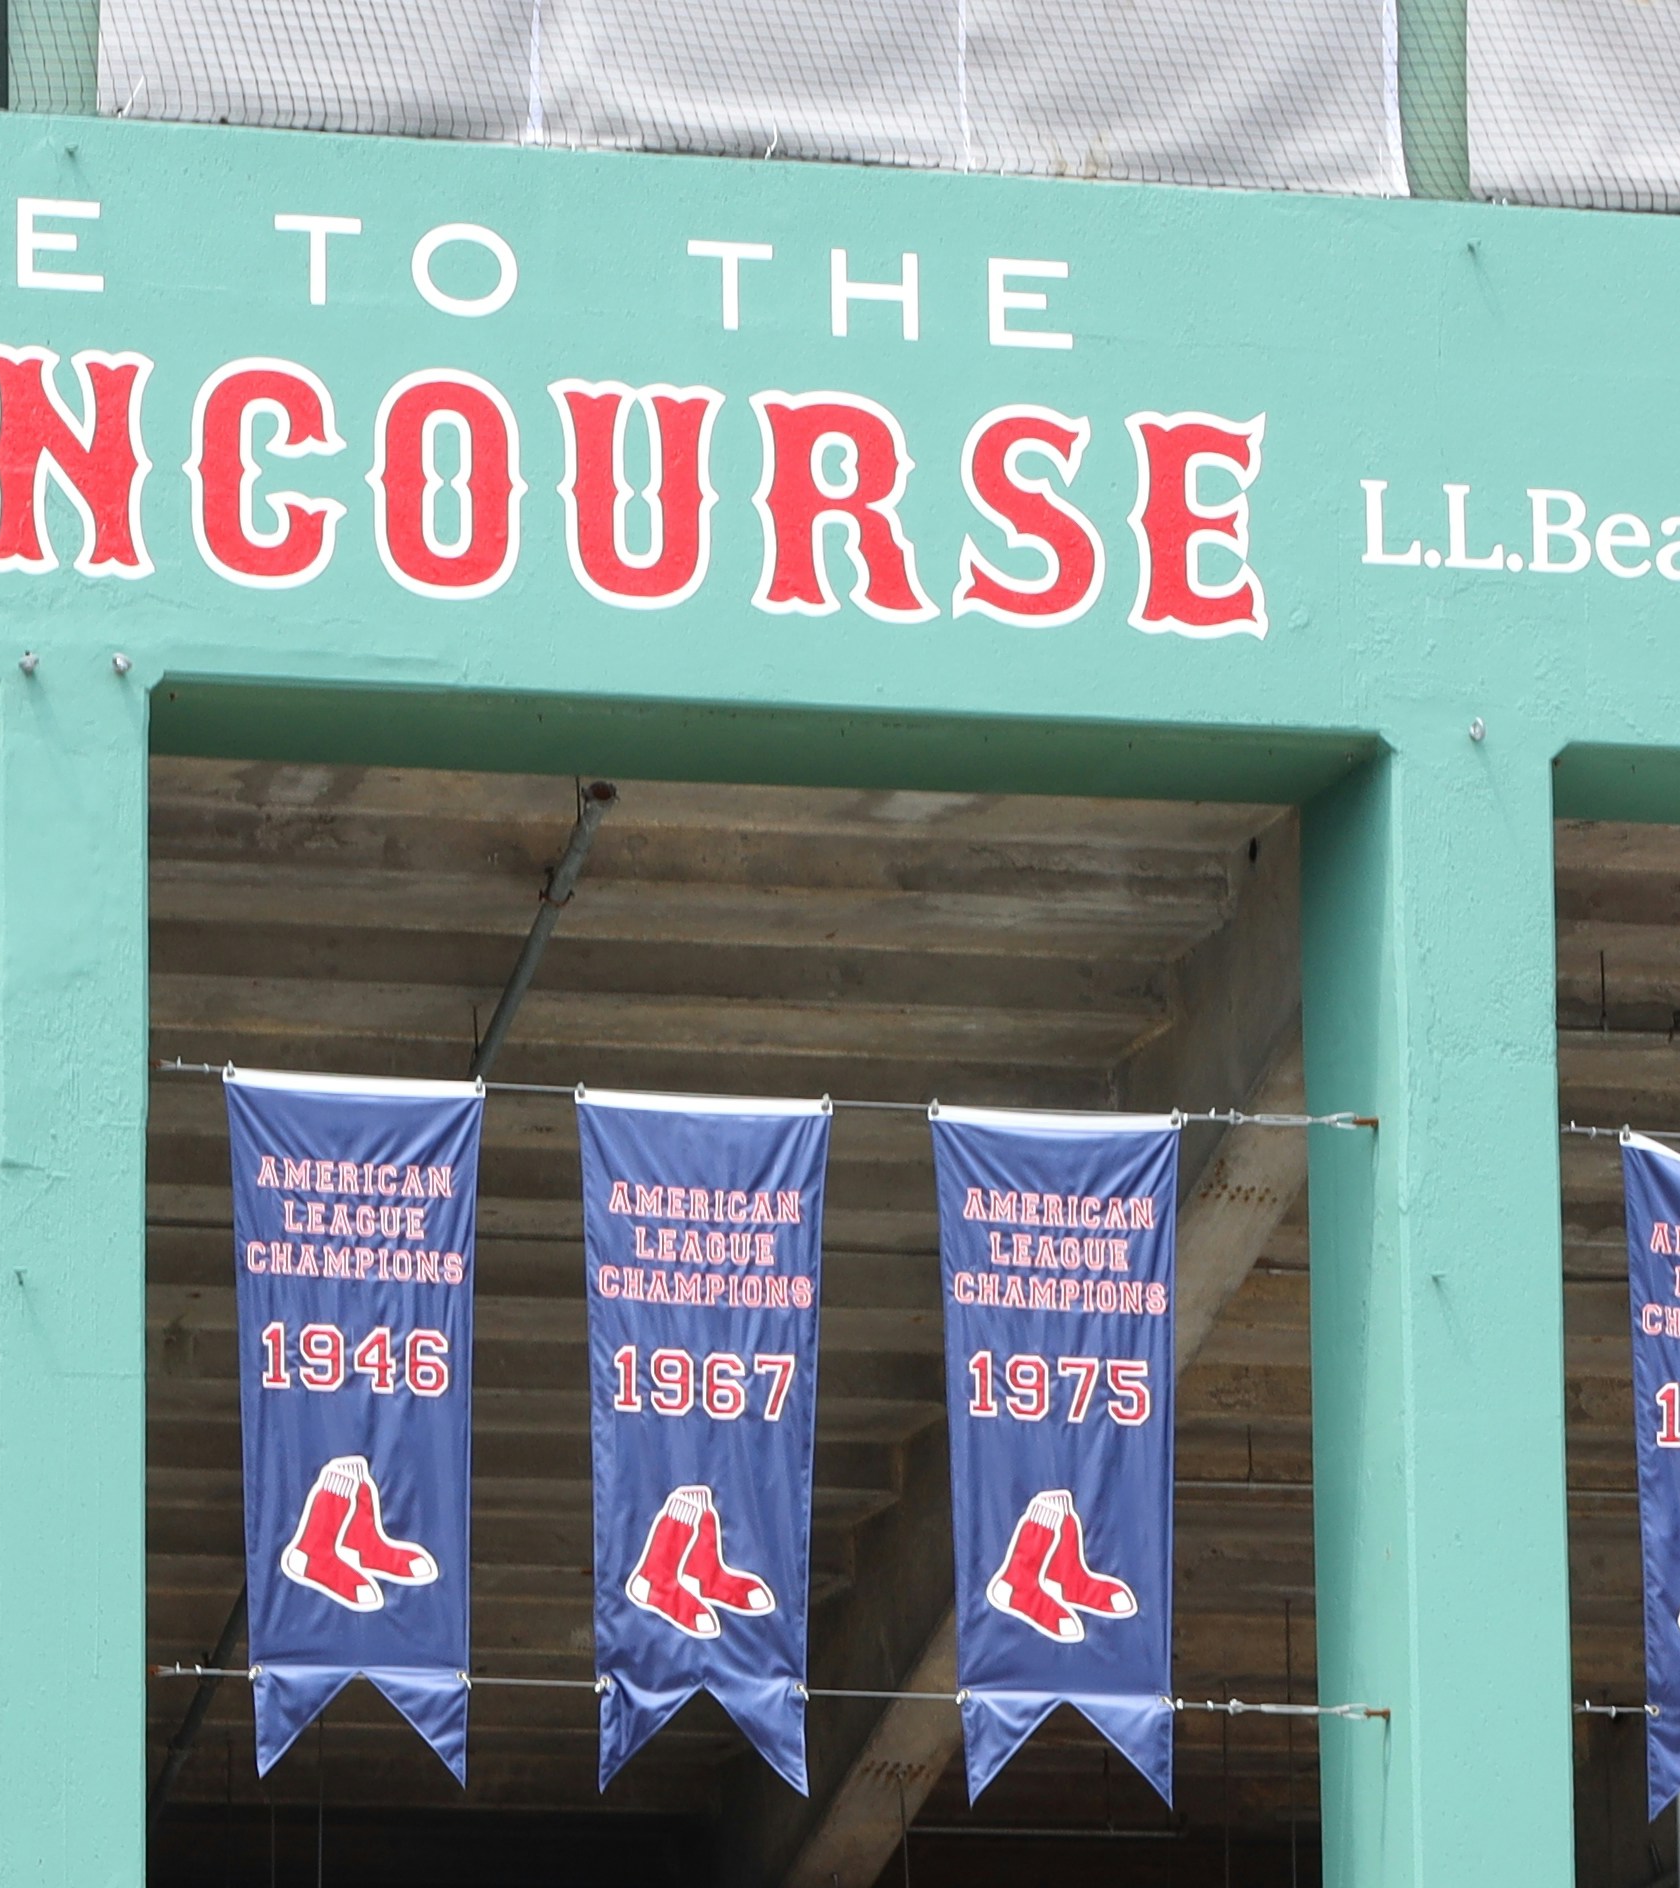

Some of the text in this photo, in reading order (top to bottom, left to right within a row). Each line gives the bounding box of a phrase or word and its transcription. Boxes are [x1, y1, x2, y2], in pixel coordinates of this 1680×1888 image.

[276, 215, 520, 316] TO
[689, 240, 1074, 348] THE
[257, 1156, 452, 1198] AMERICAN
[284, 1201, 425, 1241] LEAGUE
[609, 1181, 801, 1225] AMERICAN
[962, 1188, 1154, 1231] AMERICAN
[246, 1241, 464, 1286] CHAMPIONS
[635, 1226, 776, 1266] LEAGUE
[991, 1231, 1129, 1272] LEAGUE
[598, 1264, 813, 1309] CHAMPIONS
[954, 1272, 1168, 1315] CHAMPIONS
[261, 1321, 449, 1397] 1946
[612, 1344, 796, 1421] 1967
[968, 1350, 1151, 1426] 1975
